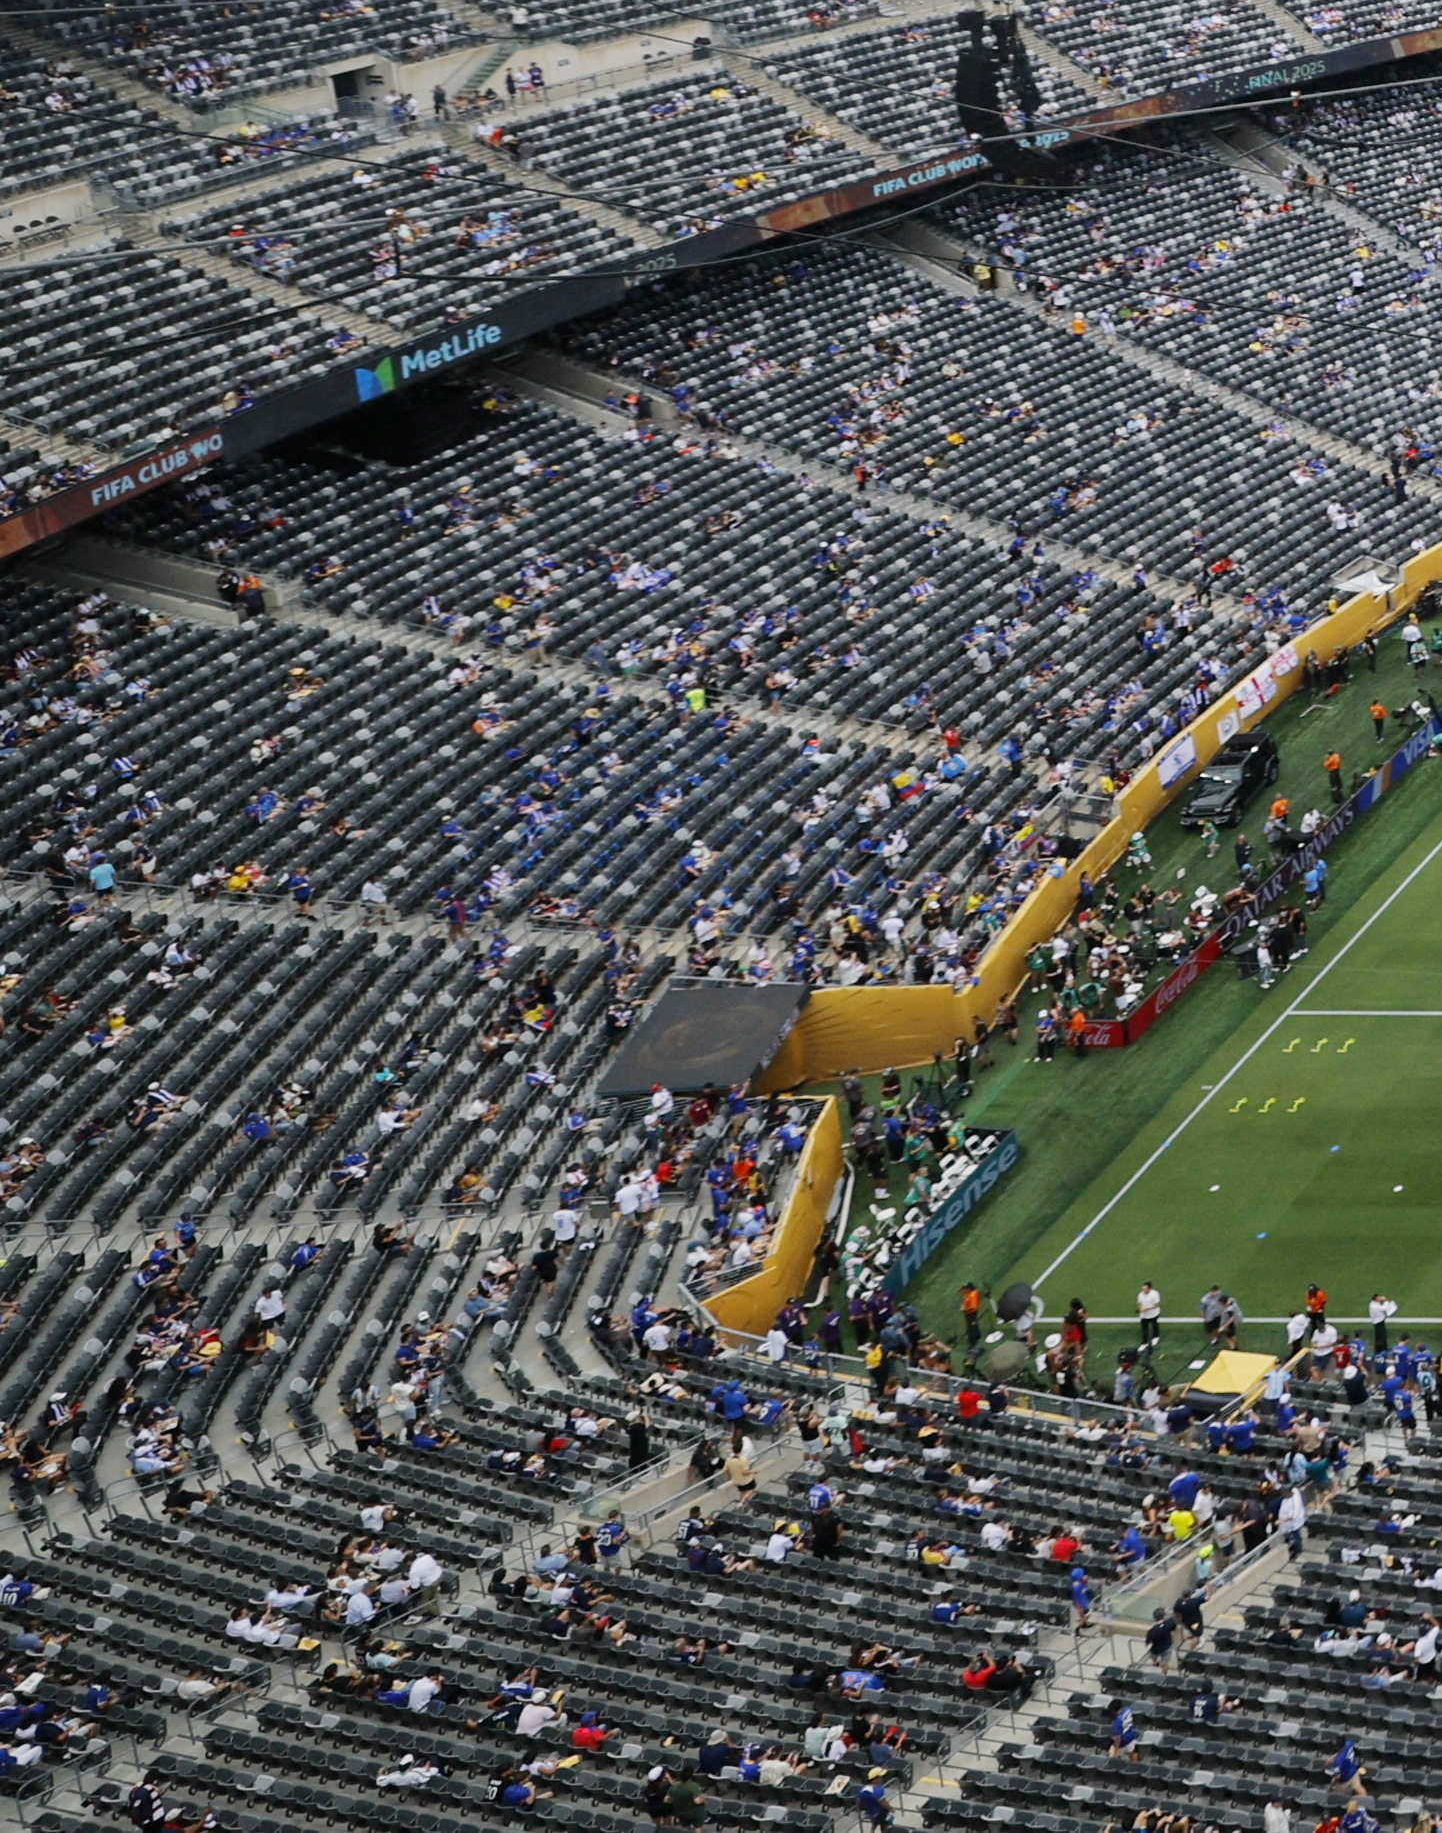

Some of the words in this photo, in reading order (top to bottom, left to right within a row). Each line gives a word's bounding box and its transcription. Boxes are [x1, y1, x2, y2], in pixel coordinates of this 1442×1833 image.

[1249, 66, 1292, 89] FINAL
[1292, 60, 1326, 79] 2025
[873, 178, 907, 198] FIFA
[907, 164, 946, 187] CLUB
[400, 323, 502, 380] MetLife
[91, 475, 136, 507] FIFA
[138, 447, 188, 484] CLUB
[1403, 720, 1436, 765] VISA
[1228, 872, 1284, 938] QATAR
[1289, 810, 1355, 874] AIRWAYS
[1156, 956, 1198, 1015] Coca-Cola
[901, 1143, 1018, 1287] Hisense
